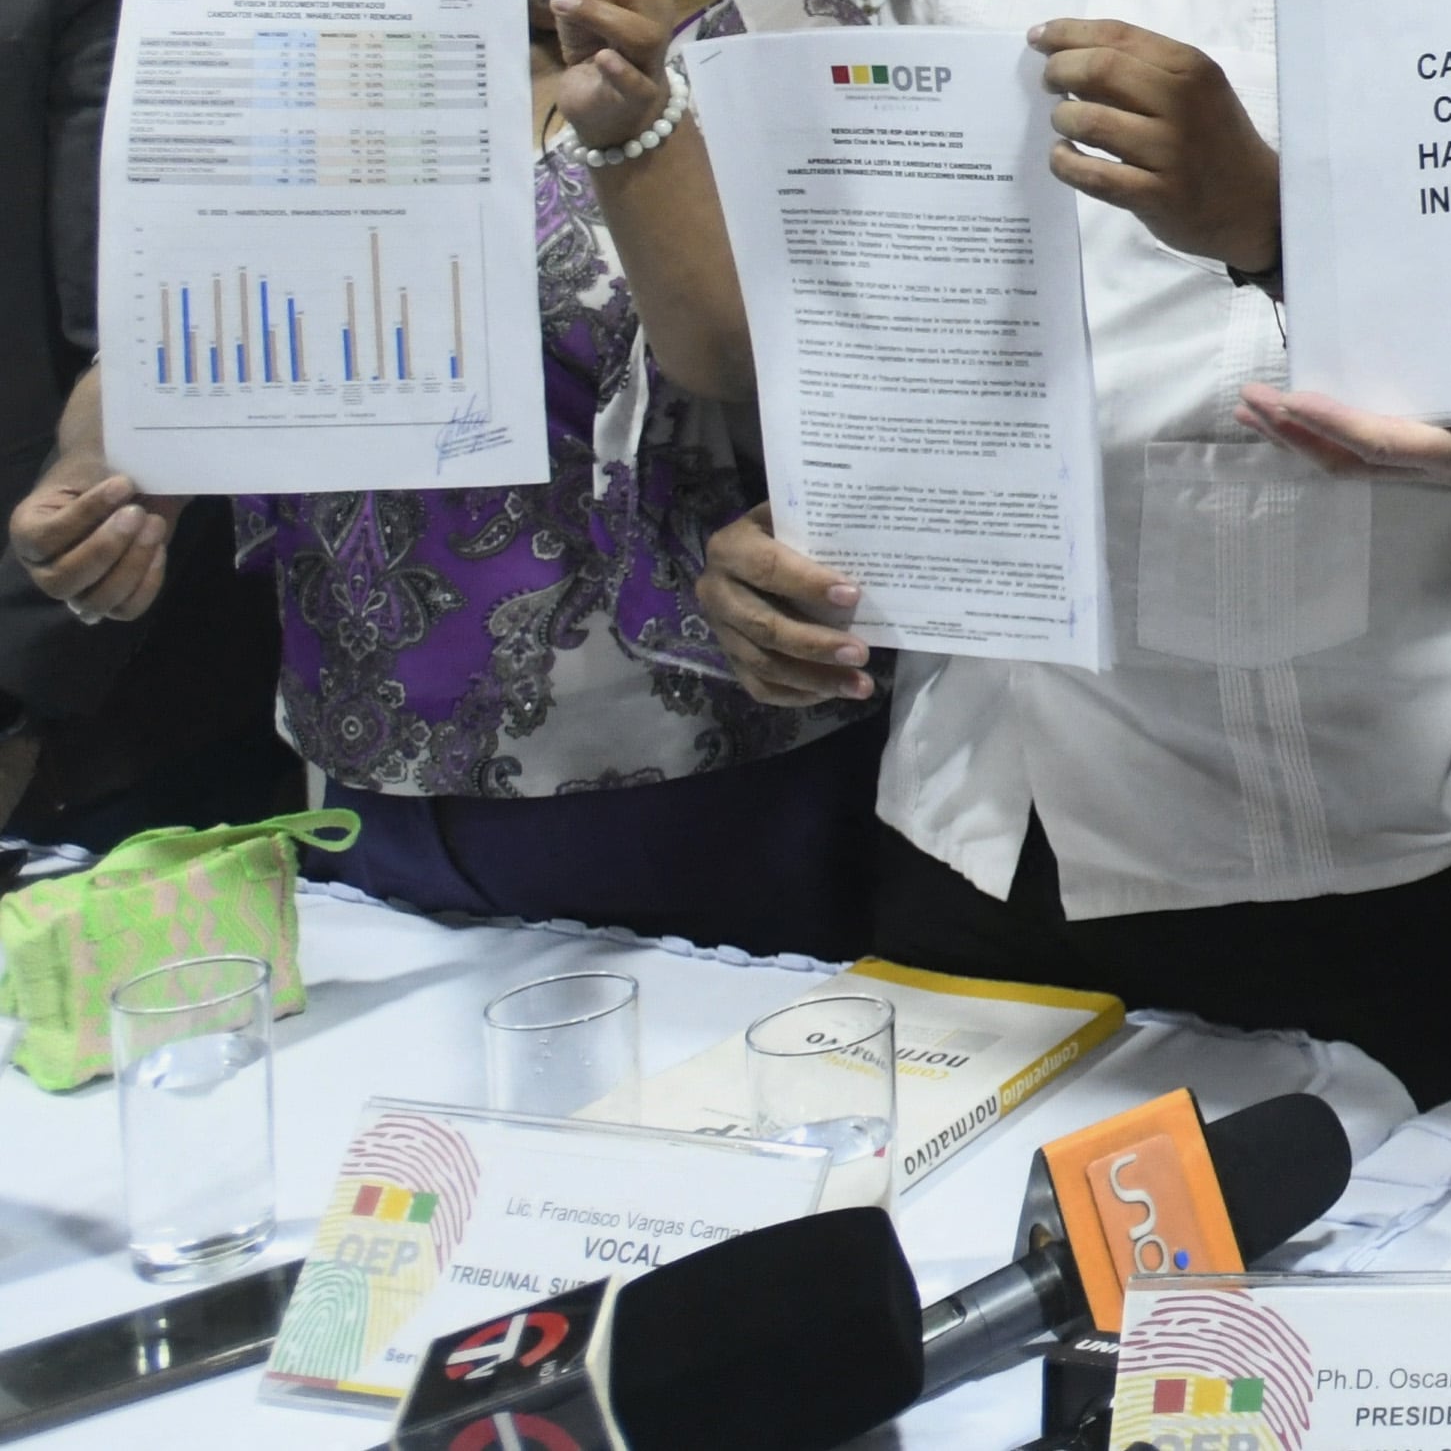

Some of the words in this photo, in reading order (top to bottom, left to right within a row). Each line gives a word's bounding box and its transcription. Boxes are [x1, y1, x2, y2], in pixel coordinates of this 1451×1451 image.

[891, 65, 952, 93] OEP
[1002, 1042, 1080, 1106] compendio
[904, 1094, 999, 1176] normativo
[506, 1197, 531, 1217] Lic.
[539, 1201, 621, 1229] Francisco
[627, 1211, 684, 1238] Vargas
[335, 1233, 420, 1278] OEP
[585, 1236, 665, 1268] VOCAL
[450, 1264, 541, 1294] TRIBUNAL
[1317, 1368, 1380, 1391] Ph.D.
